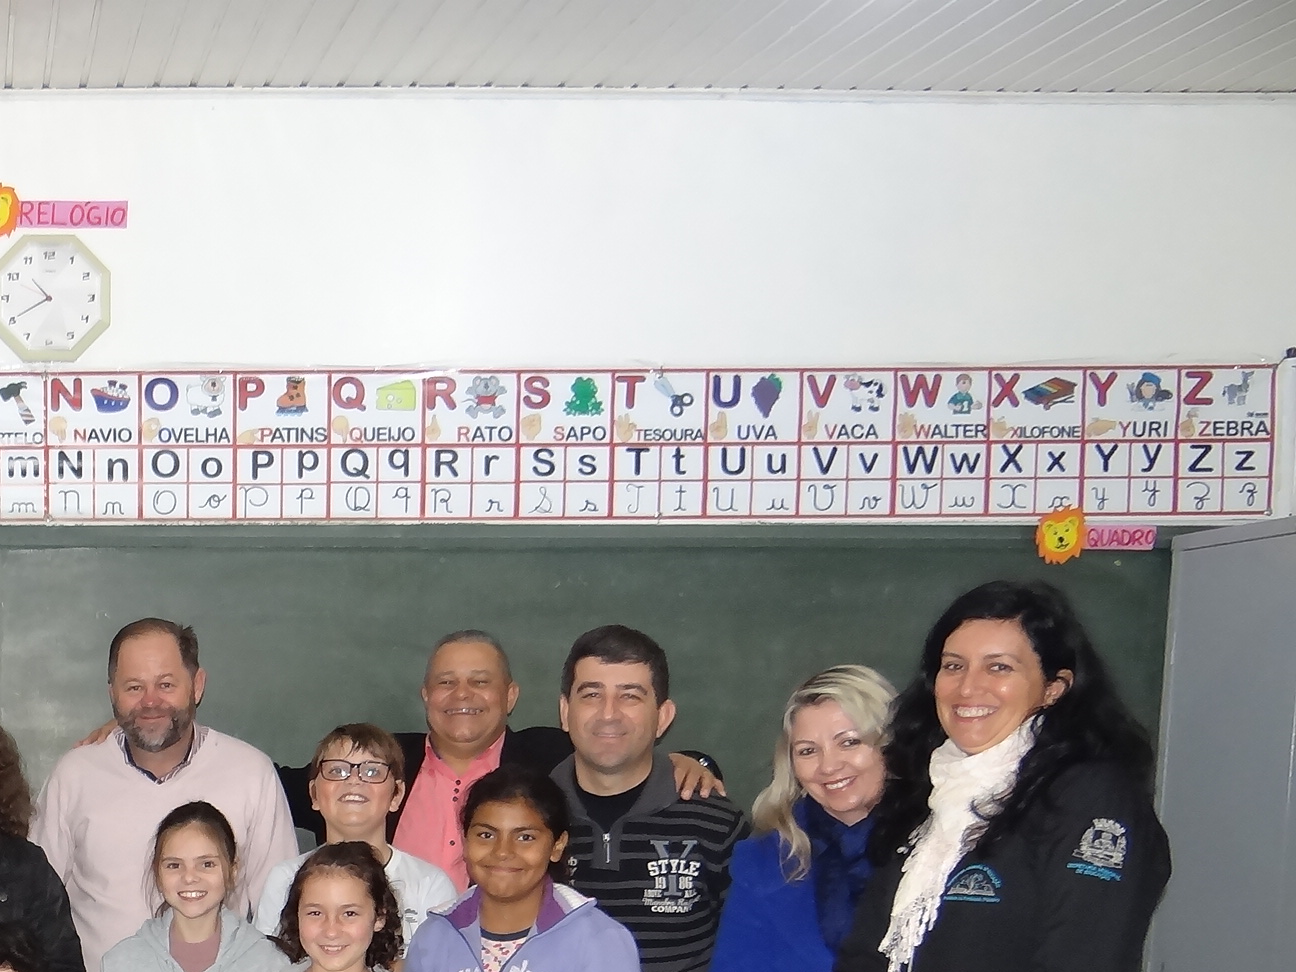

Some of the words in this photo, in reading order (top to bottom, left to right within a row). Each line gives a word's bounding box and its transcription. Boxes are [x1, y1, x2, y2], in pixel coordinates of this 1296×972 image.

[20, 200, 127, 226] RELÓGIO
[51, 377, 84, 412] N
[144, 377, 179, 411] O
[238, 377, 265, 412] P
[332, 376, 366, 412] Q
[426, 376, 456, 411] R
[522, 375, 553, 409] S
[616, 375, 646, 409] T
[712, 374, 741, 408] U
[806, 374, 837, 408] V
[899, 374, 942, 408] W
[991, 372, 1021, 408] X
[1088, 371, 1118, 407] Y
[1183, 371, 1214, 406] Z
[74, 428, 133, 444] NAVIO
[158, 427, 230, 444] OVELHA
[260, 426, 328, 443] PATINS
[349, 426, 415, 444] QUEIJO
[458, 426, 513, 442] RATO
[553, 426, 606, 441] SAPO
[635, 428, 704, 442] TESOURA
[737, 425, 777, 440] UVA
[824, 424, 879, 440] VACA
[913, 423, 988, 439] WALTER
[1010, 426, 1081, 438] XILOFONE
[1119, 421, 1168, 438] YURI
[1198, 421, 1270, 437] ZEBRA
[57, 451, 82, 480] N
[108, 458, 128, 484] n
[151, 449, 180, 478] O
[201, 457, 222, 478] o
[251, 450, 275, 480] P
[297, 449, 319, 479] p
[340, 449, 371, 479] Q
[388, 448, 410, 477] q
[435, 449, 459, 477] R
[484, 455, 499, 476] r
[532, 448, 556, 476] S
[578, 455, 597, 475] s
[625, 448, 652, 476] T
[672, 448, 686, 475] t
[721, 446, 746, 475] U
[767, 453, 786, 474] u
[812, 446, 838, 475] V
[859, 453, 878, 474] v
[902, 446, 939, 474] W
[950, 453, 981, 474] w
[999, 444, 1023, 473] X
[1047, 451, 1066, 472] x
[1095, 444, 1119, 472] Y
[1141, 444, 1163, 472] y
[1187, 444, 1214, 472] Z
[1235, 451, 1255, 471] z
[1087, 527, 1156, 548] QUADRO
[647, 859, 701, 877] STYLE
